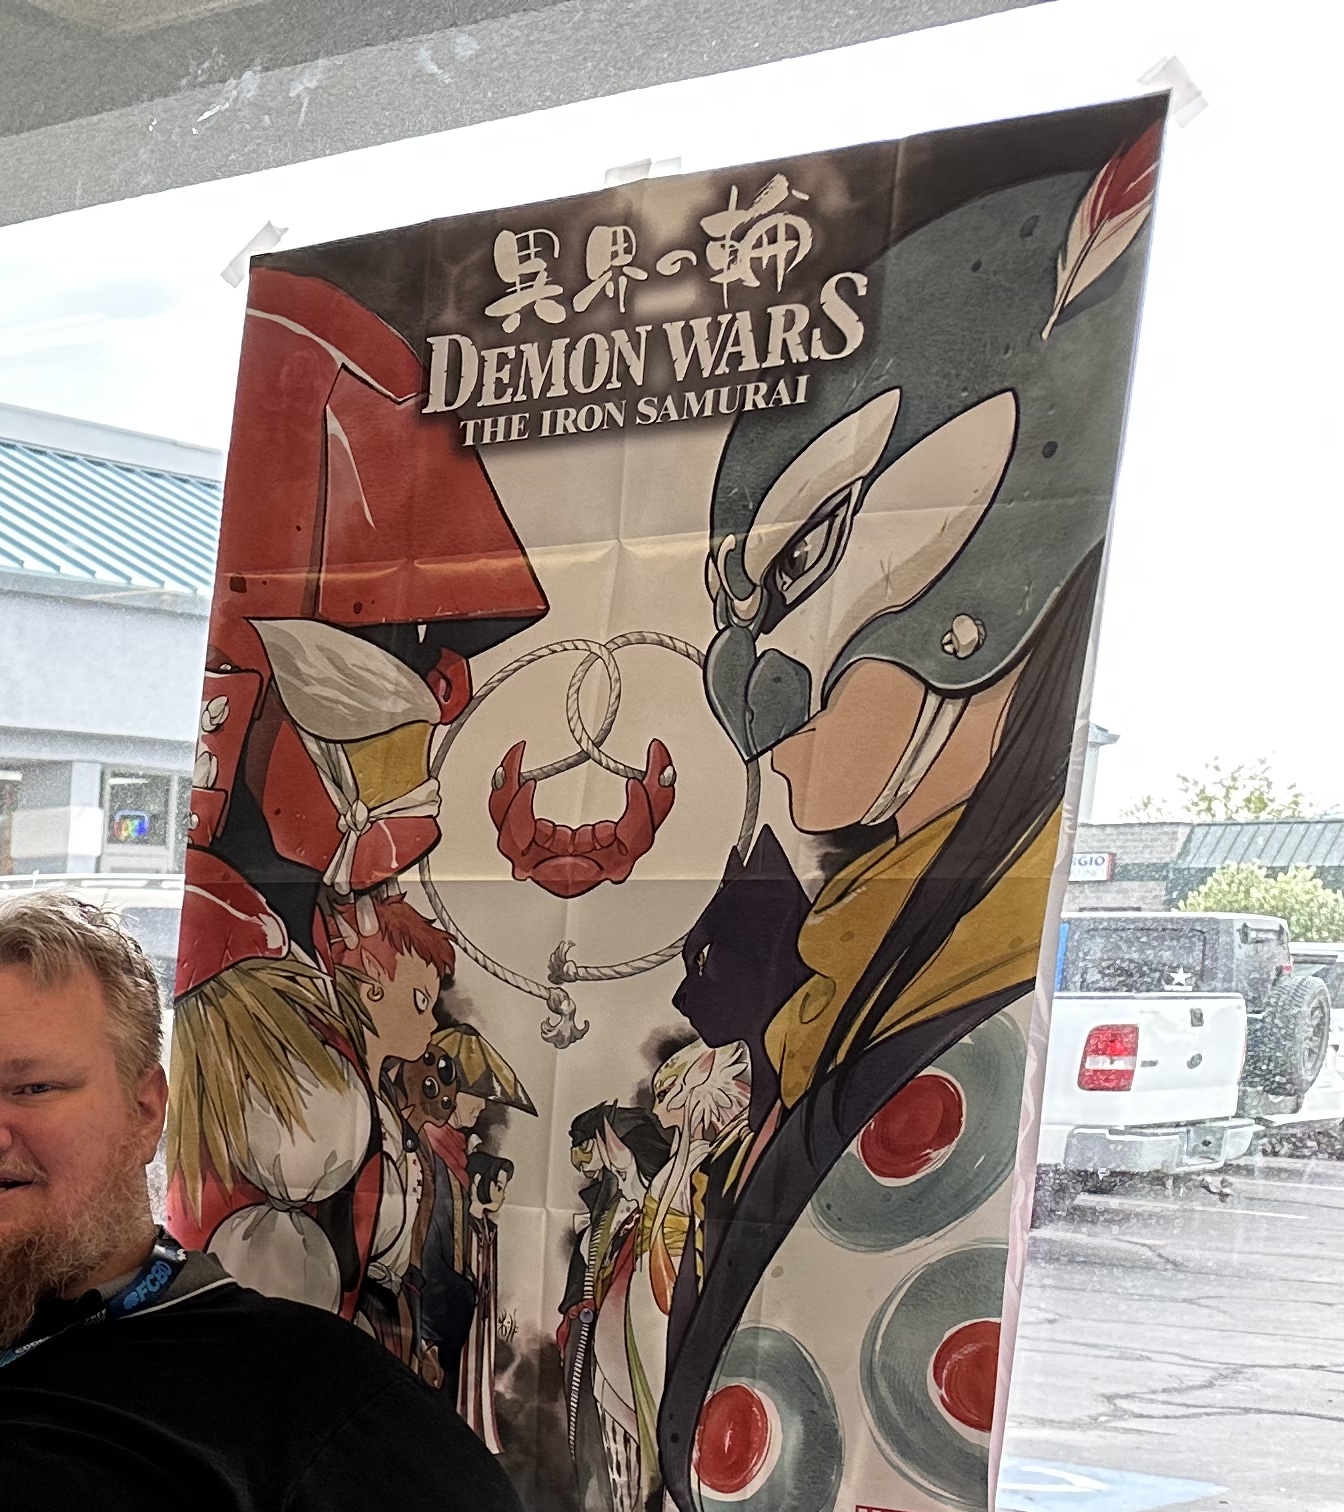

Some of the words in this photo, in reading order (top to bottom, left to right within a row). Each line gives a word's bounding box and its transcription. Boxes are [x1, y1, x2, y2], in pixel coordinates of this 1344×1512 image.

[421, 322, 654, 415] DEMON
[662, 271, 870, 382] WARS
[459, 413, 530, 448] THE
[540, 398, 629, 436] IRON
[636, 375, 811, 427] SAMURAI
